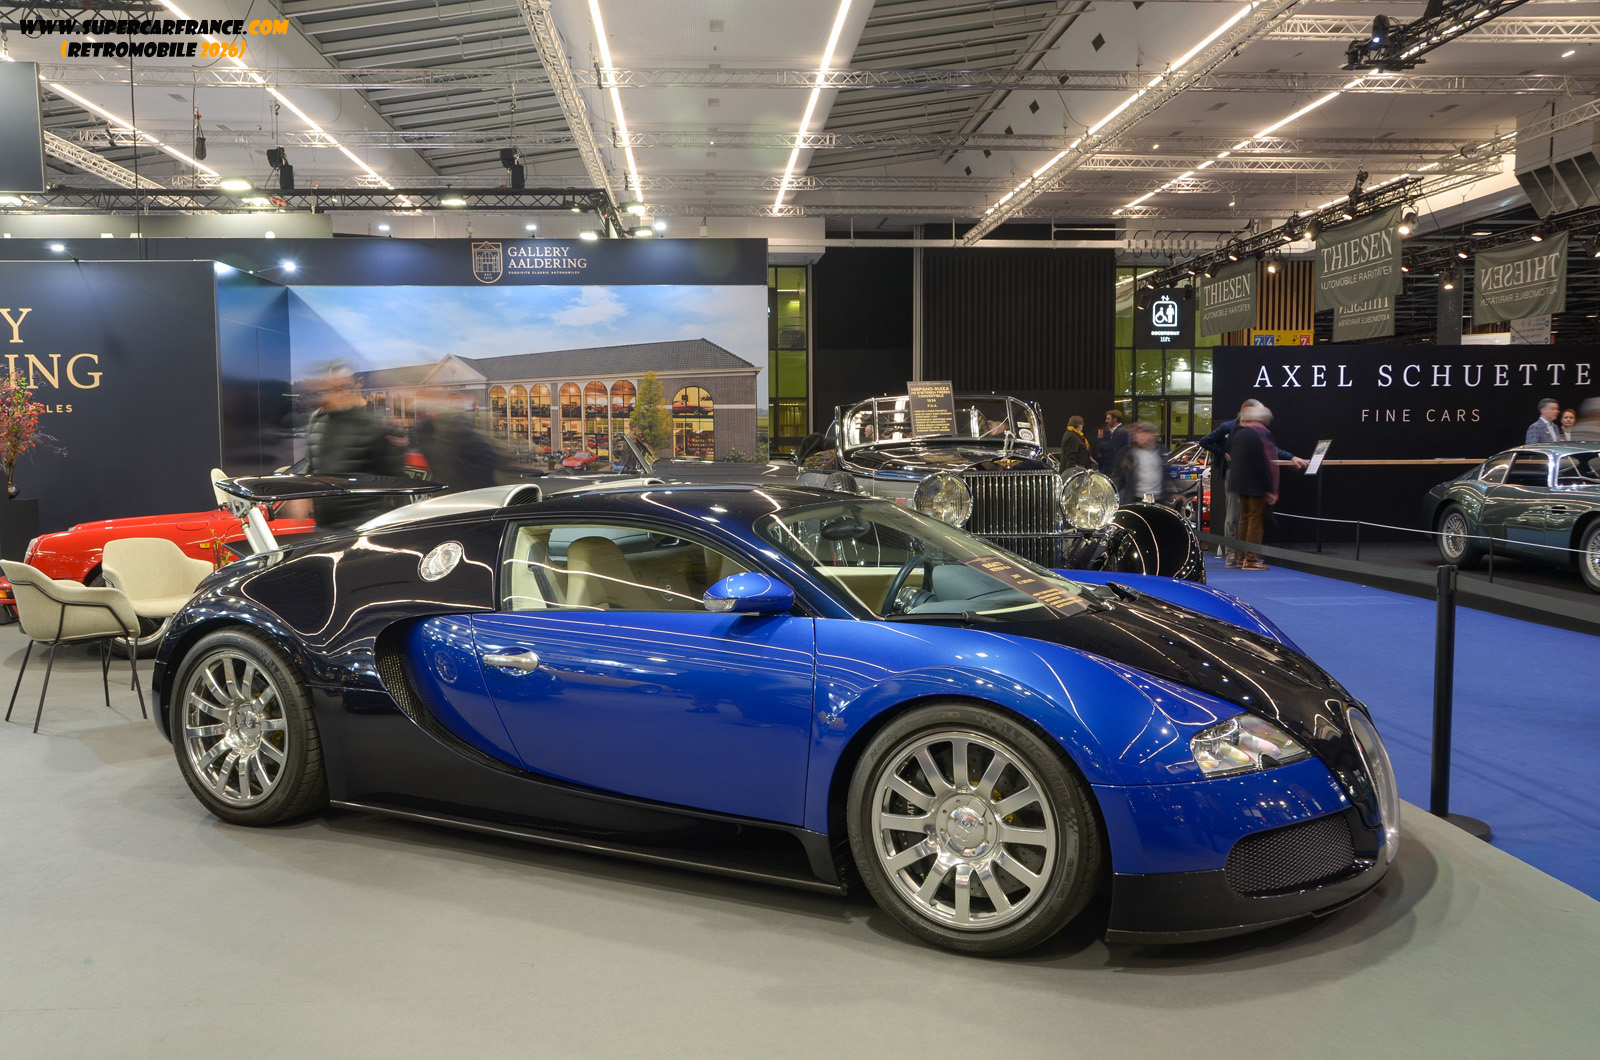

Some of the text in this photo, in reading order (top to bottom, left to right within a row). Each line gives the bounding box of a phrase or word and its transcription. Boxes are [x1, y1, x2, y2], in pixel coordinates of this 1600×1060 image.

[507, 246, 570, 257] GALLERY
[1321, 227, 1394, 273] THIESEN
[507, 258, 587, 269] AALDERING
[1204, 273, 1251, 307] THIESEN
[1253, 363, 1592, 388] AXEL SCHUETTE
[1361, 409, 1480, 422] FINE CARS
